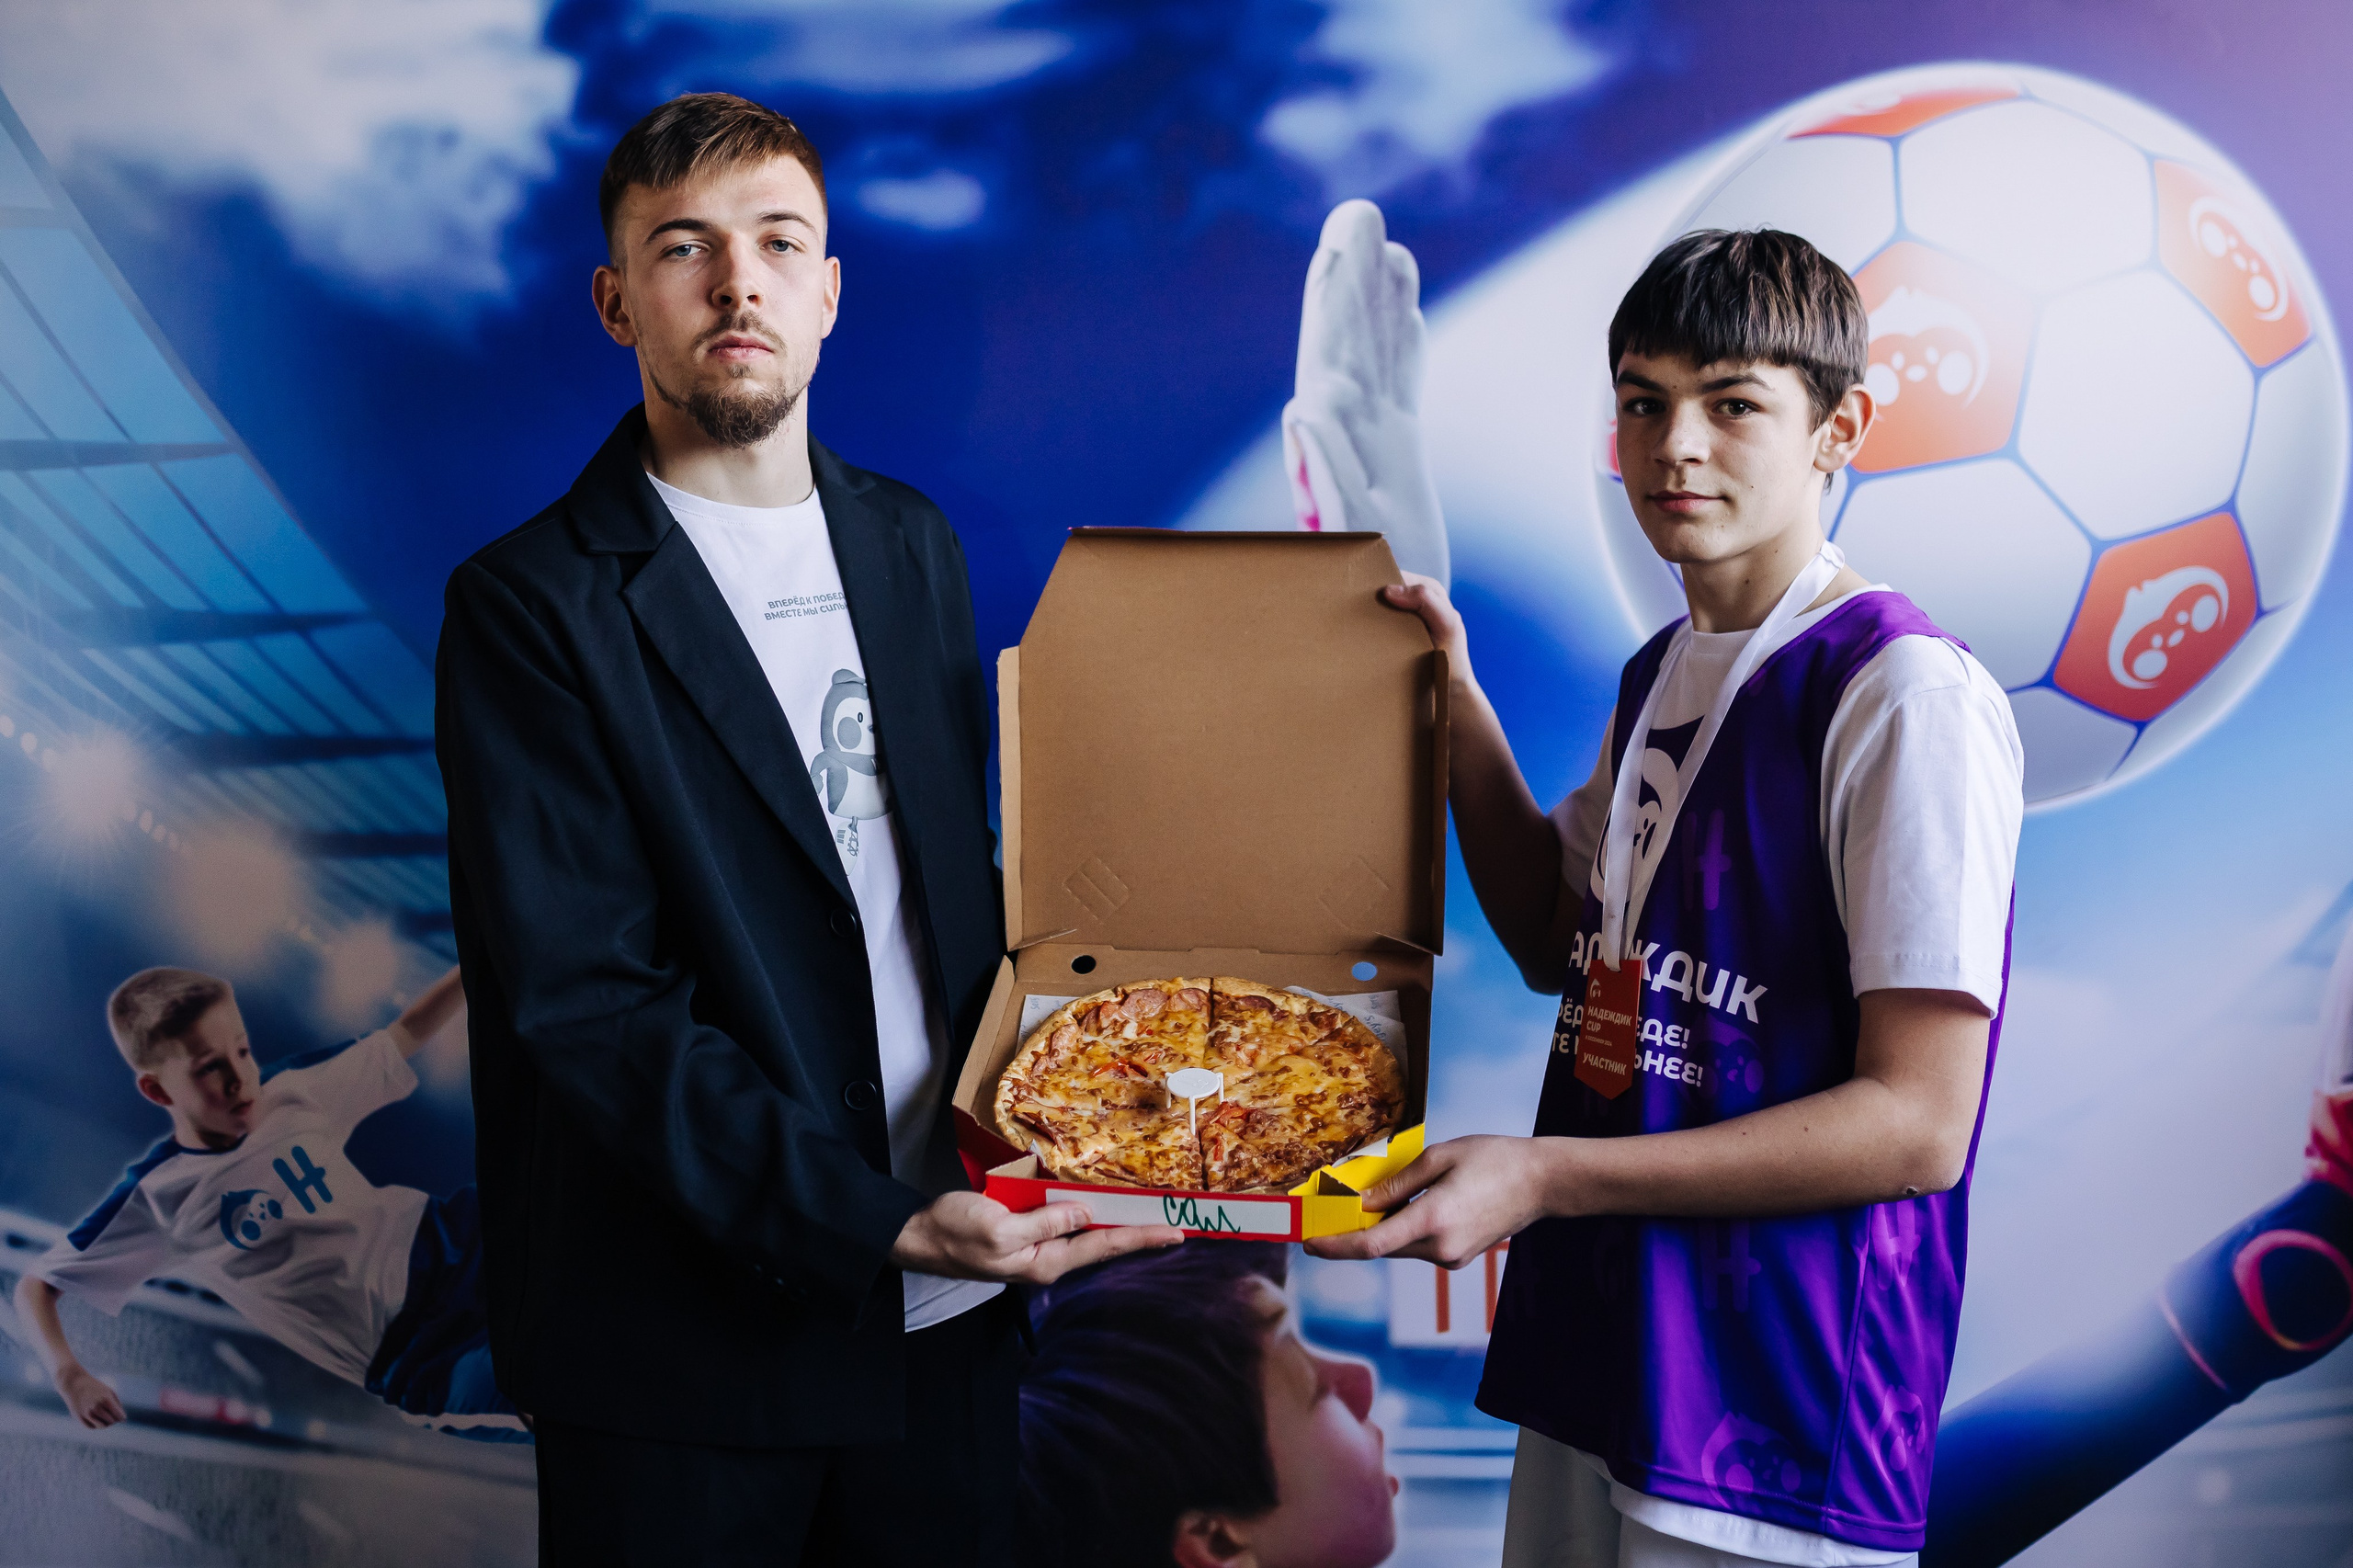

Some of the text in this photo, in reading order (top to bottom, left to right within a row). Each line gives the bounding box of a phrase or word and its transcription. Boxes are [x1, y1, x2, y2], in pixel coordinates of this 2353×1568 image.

[767, 596, 805, 608] ВПЕРЁД
[806, 597, 813, 605] К
[764, 608, 802, 620] ВМЕСТЕ
[802, 607, 818, 617] МЫ
[1587, 1006, 1632, 1027] НАДЕЖДИК
[1586, 1020, 1601, 1033] CUP
[1582, 1052, 1627, 1075] УЧАСТНИК
